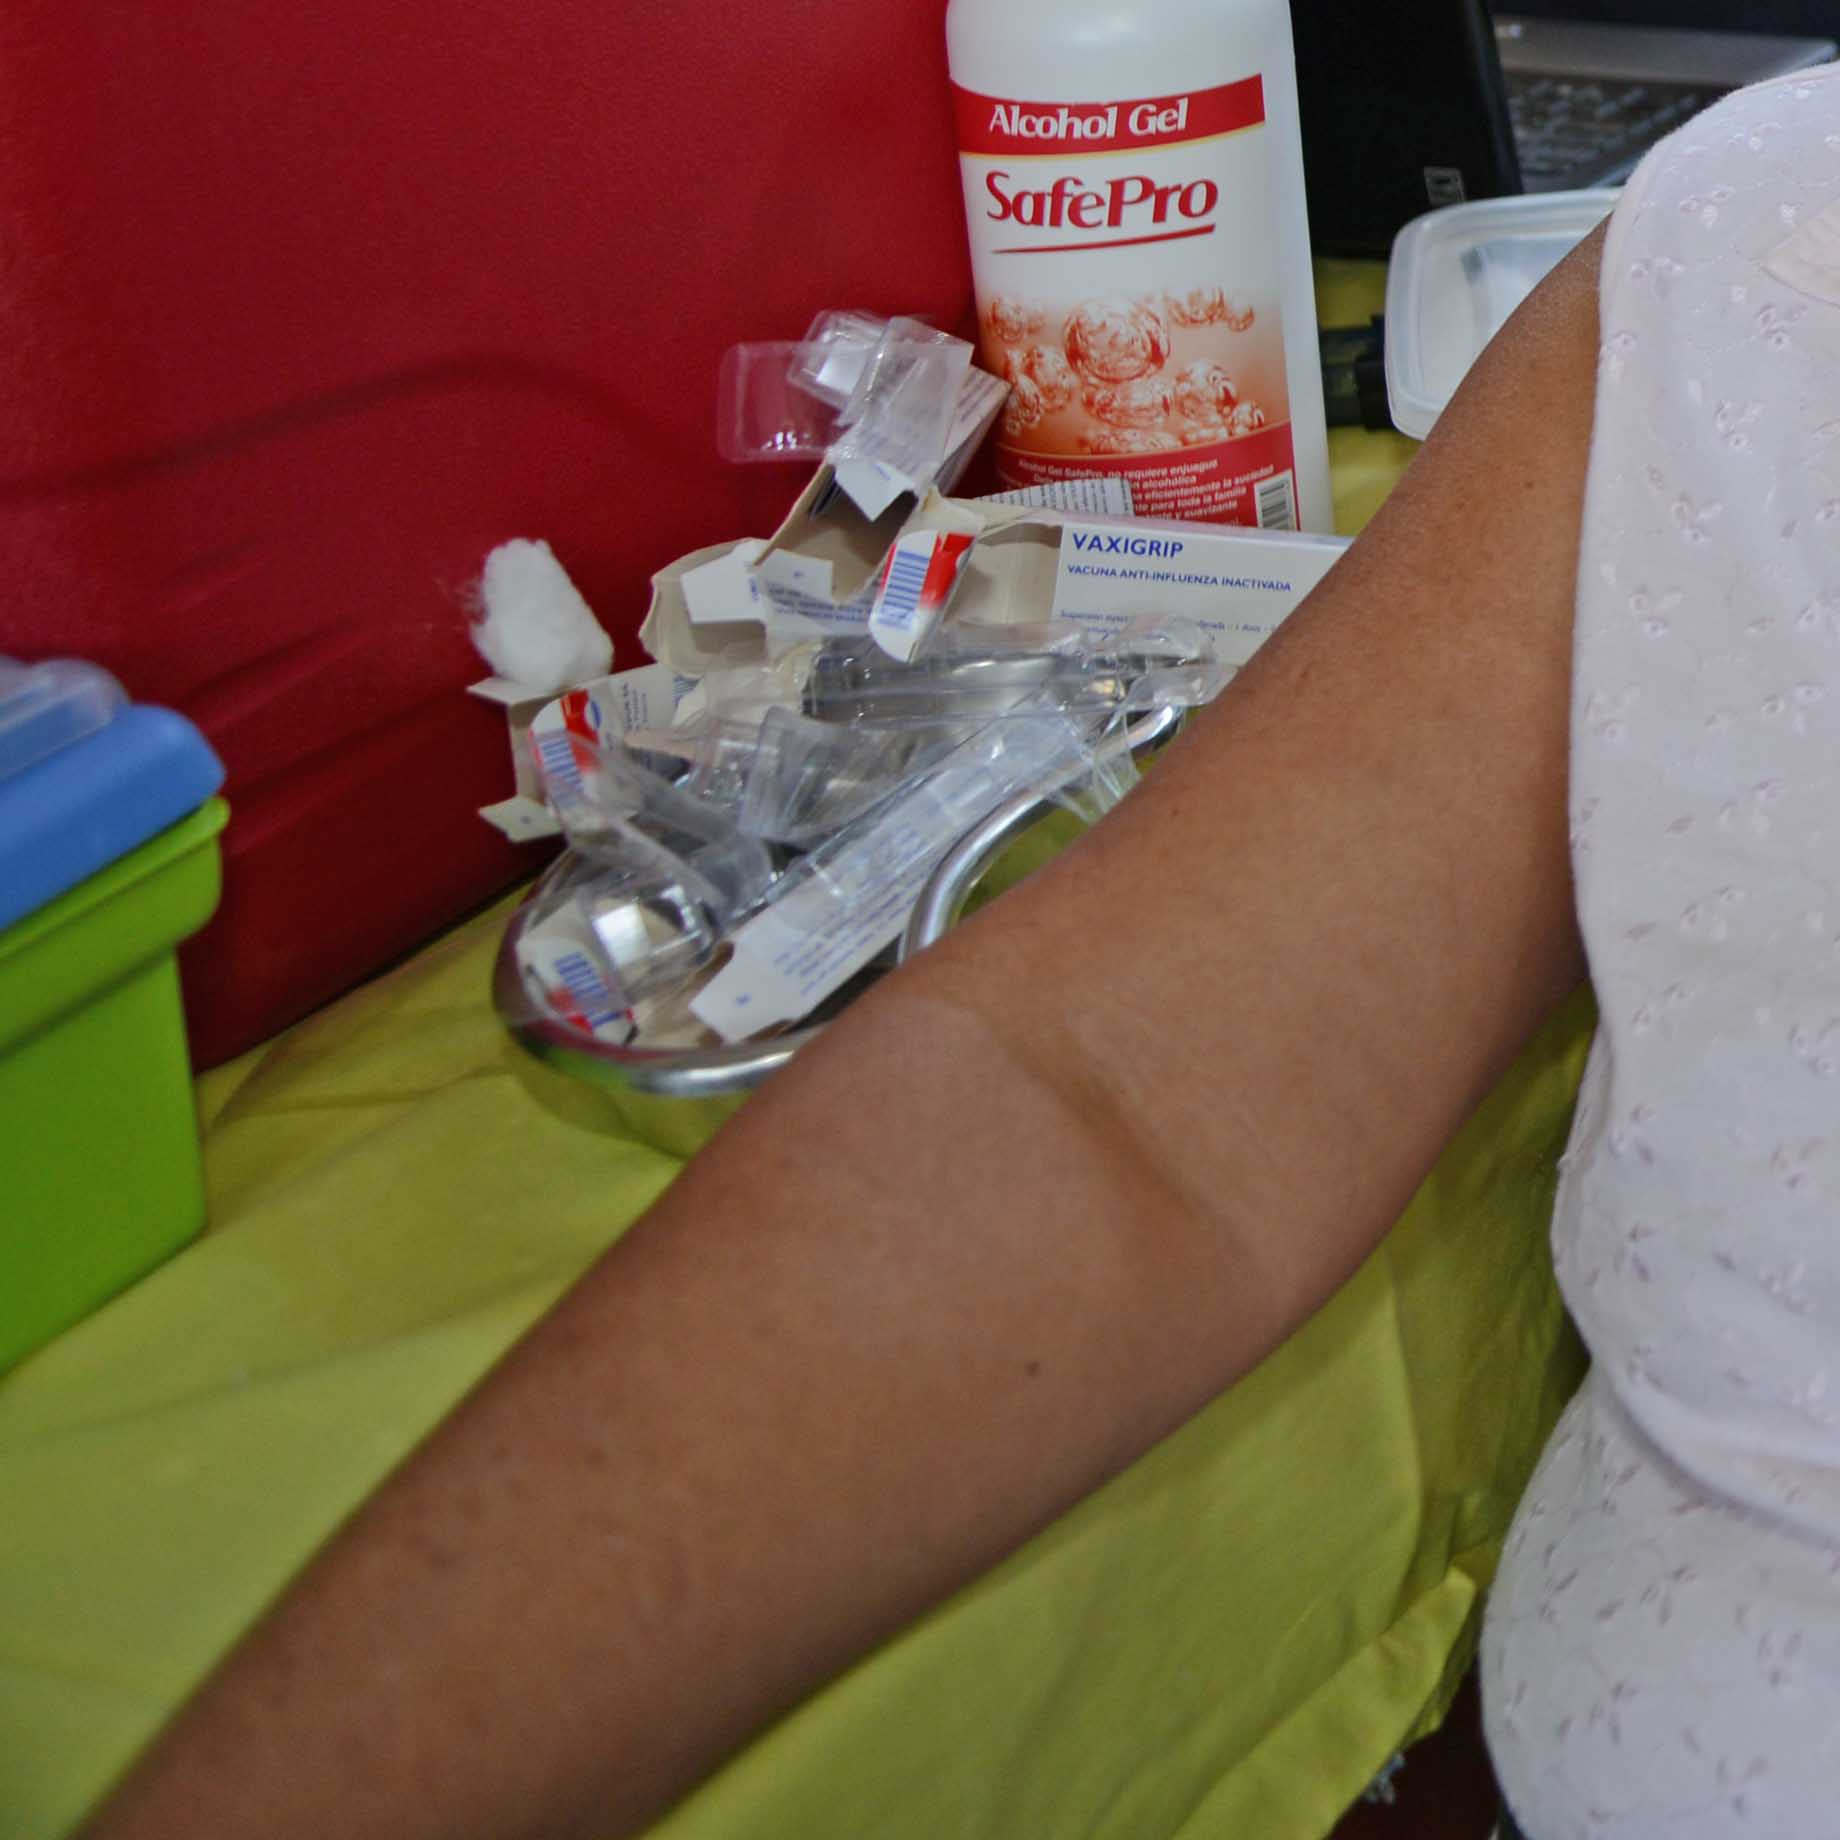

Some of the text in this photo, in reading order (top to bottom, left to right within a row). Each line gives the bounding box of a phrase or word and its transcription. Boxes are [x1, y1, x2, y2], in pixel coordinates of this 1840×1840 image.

[989, 97, 1189, 140] Alcohol Gel
[985, 170, 1219, 229] SafePro
[1072, 533, 1184, 559] VAXIGRIP
[1066, 564, 1293, 593] VACUNA ANTI-INFLUENZA INACTIVADA
